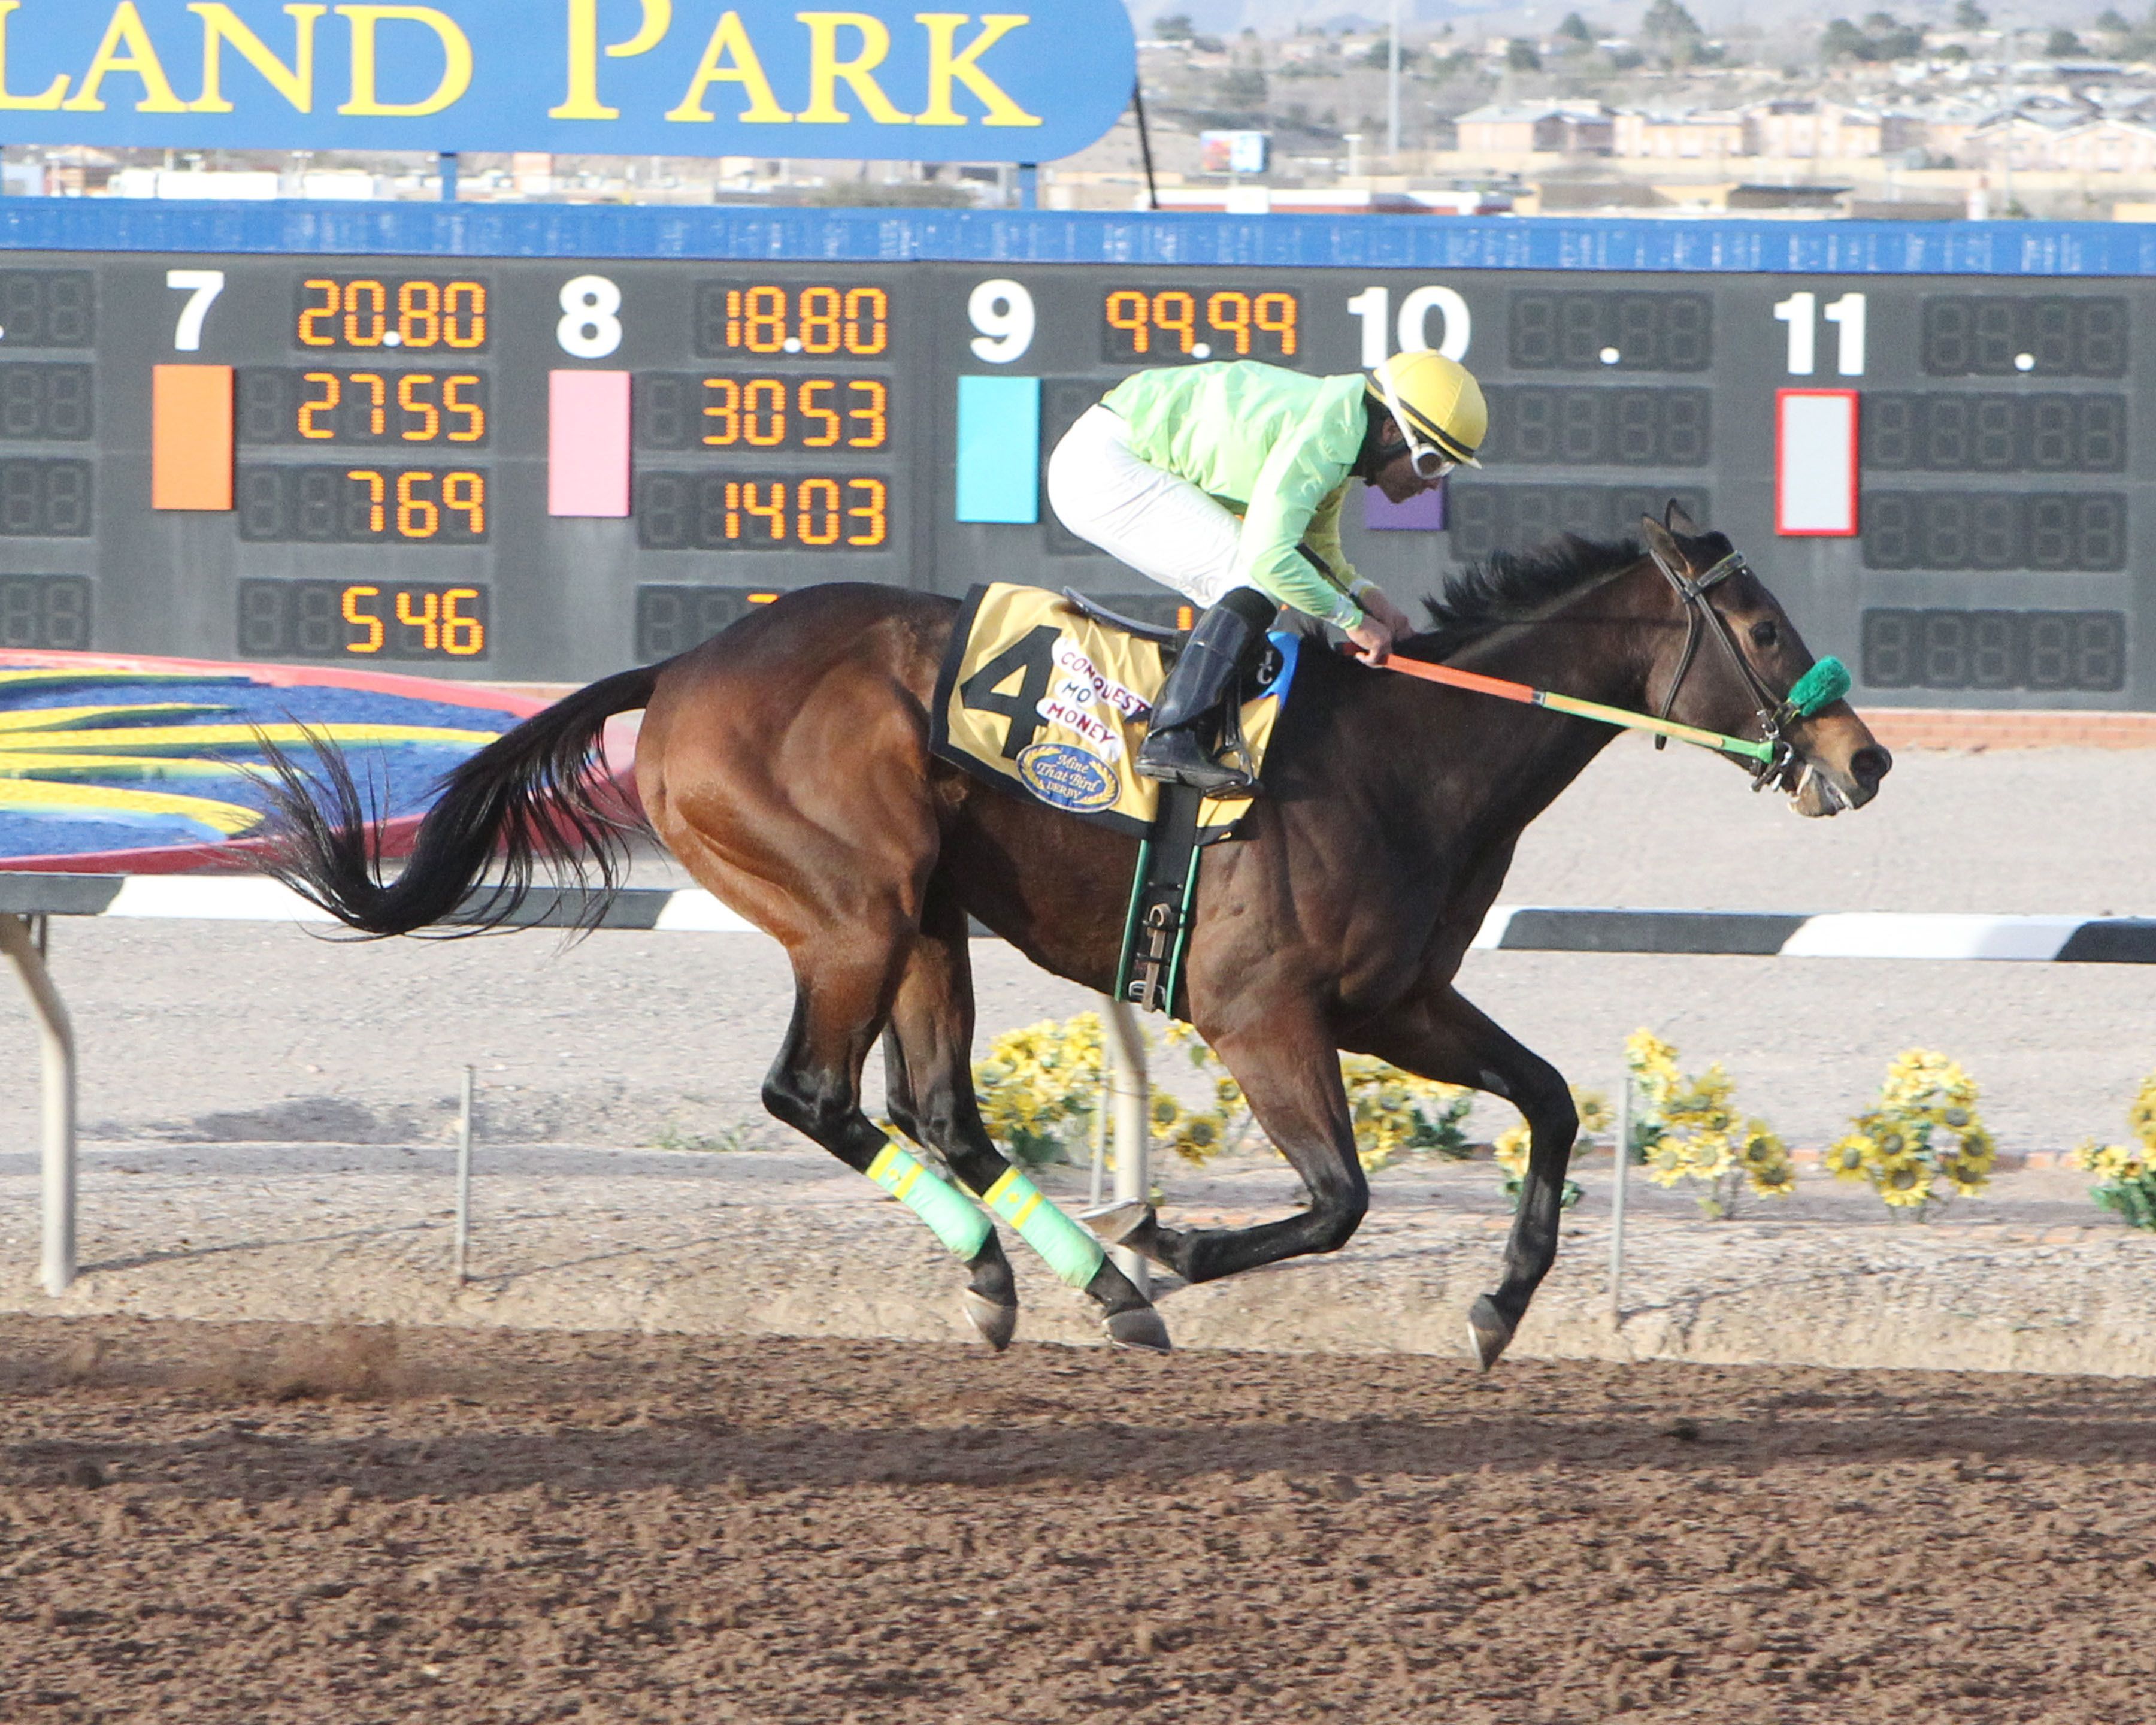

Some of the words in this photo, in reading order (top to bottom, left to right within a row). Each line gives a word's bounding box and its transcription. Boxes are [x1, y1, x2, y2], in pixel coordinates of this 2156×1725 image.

[0, 0, 473, 116] LAND
[549, 0, 1043, 126] PARK
[167, 270, 225, 351] 7
[298, 279, 486, 348] 20.80
[556, 274, 623, 358] 8
[726, 286, 888, 355] 18.80
[968, 279, 1035, 364] 9
[1106, 290, 1297, 358] 99.99
[1347, 286, 1471, 368] 10
[1773, 292, 1866, 375] 11
[298, 373, 485, 441] 2755
[703, 379, 887, 448] 3053
[347, 471, 484, 537] 769
[725, 478, 886, 546] 1403
[341, 586, 484, 655] 546
[960, 624, 1062, 759] 4
[1061, 652, 1147, 713] CONQUEST
[1062, 681, 1091, 703] MO
[1047, 702, 1116, 744] MONEY
[1036, 762, 1068, 782] That
[1068, 773, 1103, 792] Bird
[1047, 780, 1082, 800] DERBY
[1056, 754, 1090, 773] Mine
